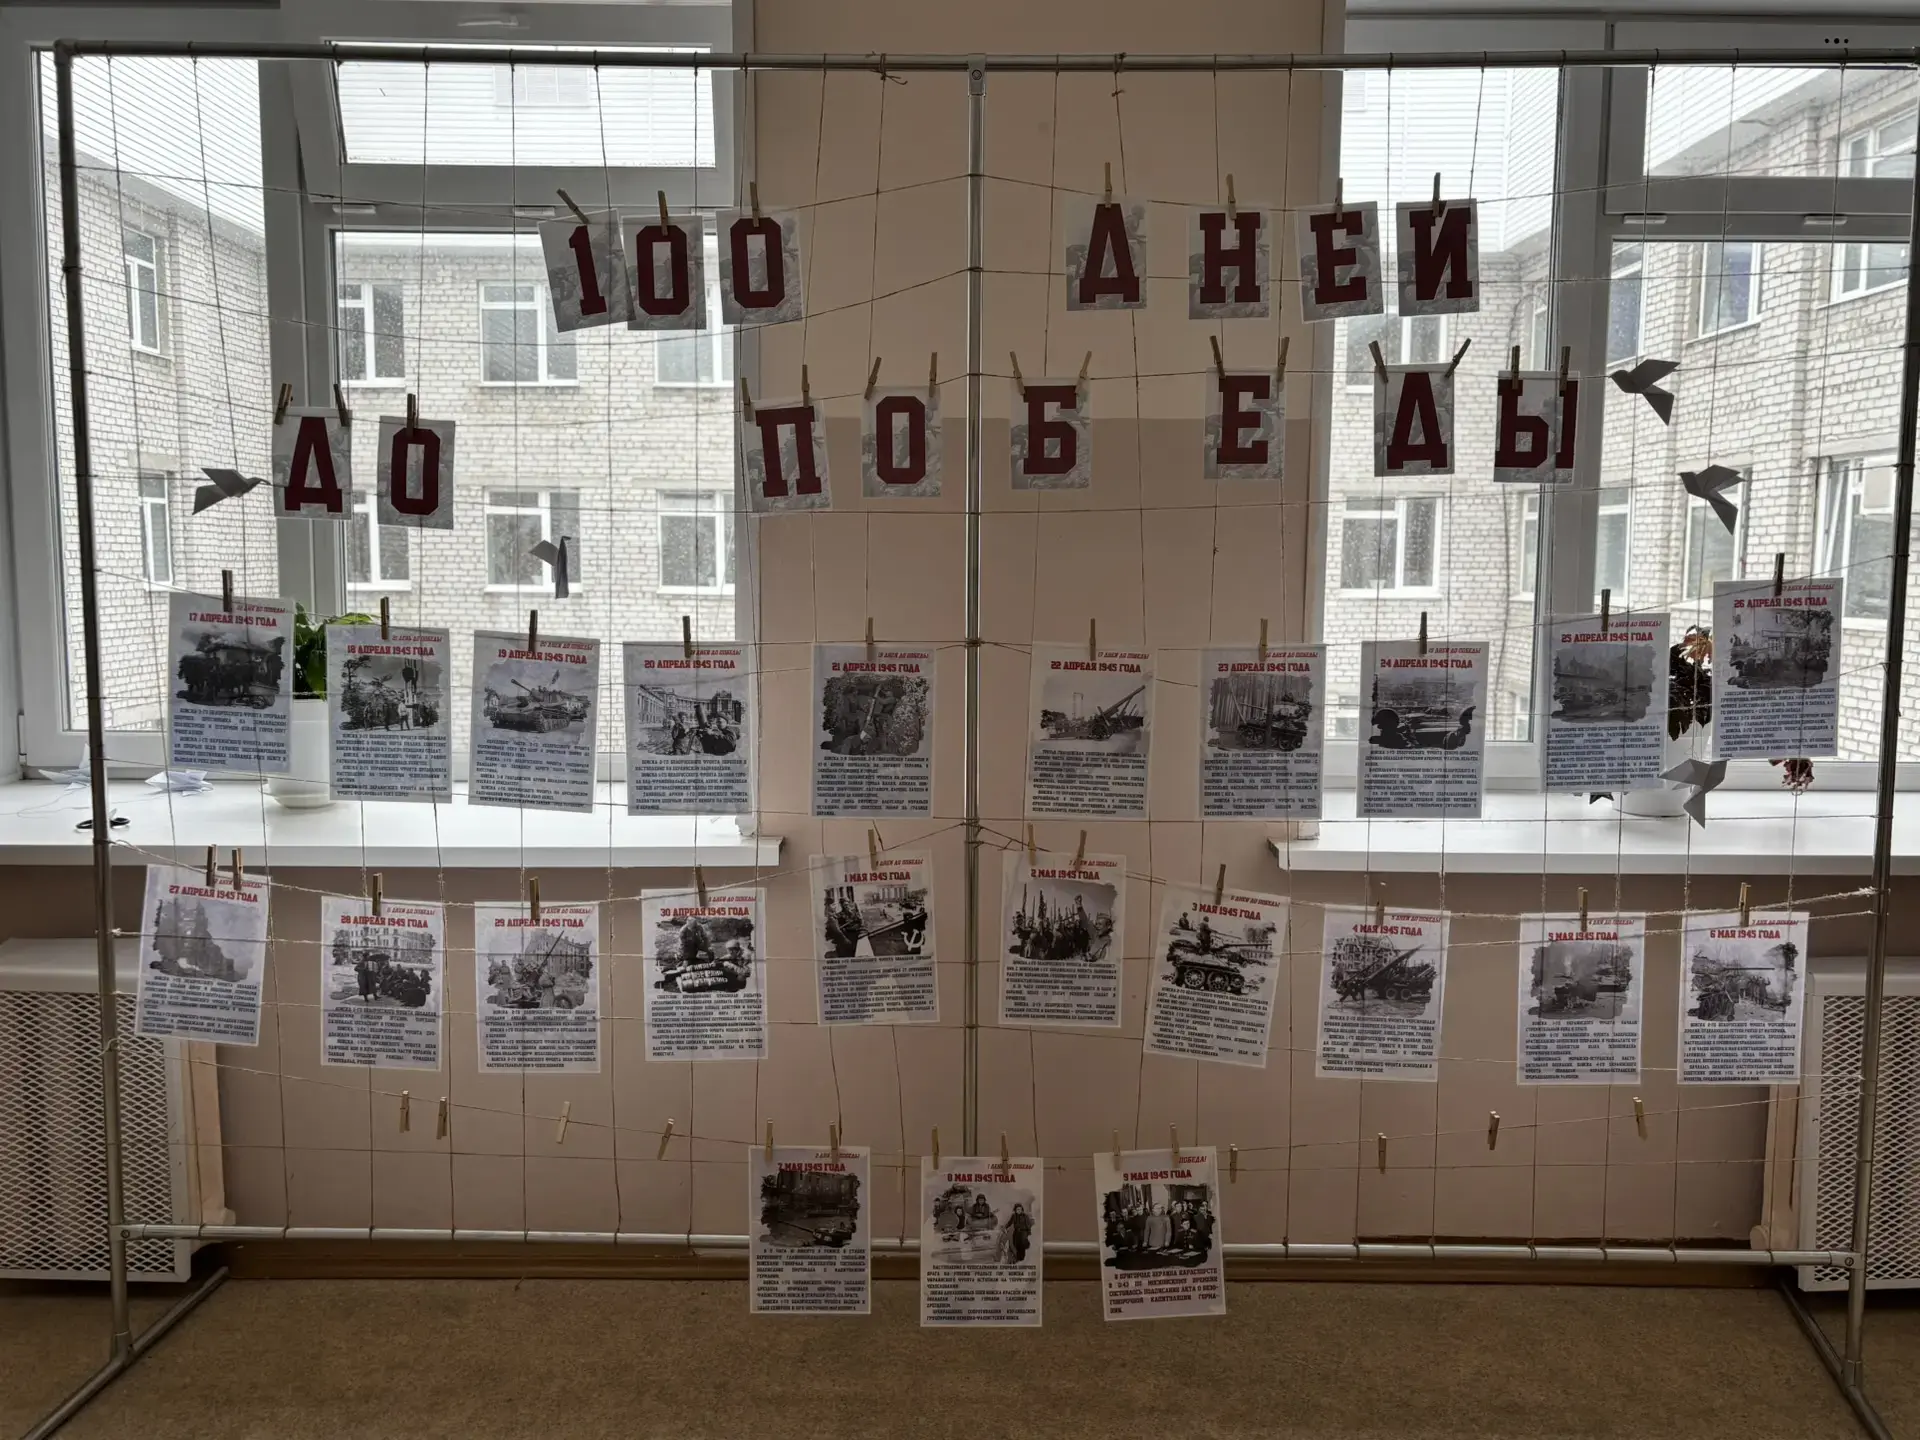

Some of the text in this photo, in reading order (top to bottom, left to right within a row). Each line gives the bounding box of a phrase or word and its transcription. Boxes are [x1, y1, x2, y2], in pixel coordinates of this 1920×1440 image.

[568, 217, 786, 316] 100
[284, 372, 1579, 516] ДО ПОБЕДЫ
[1734, 597, 1827, 608] 26 АПРЕЛЯ 1945 ГОДА
[189, 612, 277, 626] 17 АПРЕЛЯ 1945 ГОДА
[1562, 633, 1653, 642] 25 АПРЕЛЯ 1945 ГОДА
[348, 645, 355, 653] 18
[358, 646, 390, 654] АПРЕЛЯ
[413, 647, 434, 655] ГОДА
[498, 649, 587, 664] 19 АПРЕЛЯ 1945 ГОДА
[644, 660, 735, 668] 20 АПРЕЛЯ 1945 ГОДА
[832, 663, 840, 671] 21
[843, 663, 875, 672] АПРЕЛЯ
[899, 664, 920, 672] ГОДА
[1051, 661, 1141, 672] 22 АПРЕЛЯ 1945 ГОДА
[1288, 664, 1310, 672] ГОДА
[1380, 659, 1472, 668] 24 АПРЕЛЯ 1945 ГОДА
[844, 874, 847, 882] 1
[870, 873, 887, 881] 1945
[890, 872, 910, 880] ГОДА
[1031, 869, 1036, 877] 2
[1059, 870, 1076, 878] 1945
[1079, 871, 1100, 880] ГОДА
[169, 885, 257, 902] 27 АПРЕЛЯ 1945 ГОДА
[673, 908, 706, 916] АПРЕЛЯ
[708, 908, 725, 916] 1945
[728, 907, 749, 916] ГОДА
[1192, 903, 1261, 920] 3 МАЯ 1945 ГОДА
[353, 916, 385, 925] АПРЕЛЯ
[388, 918, 405, 926] 1945
[408, 919, 428, 928] ГОДА
[495, 919, 583, 927] 29 АПРЕЛЯ 1945 ГОДА
[1360, 925, 1378, 933] МАЯ
[1380, 926, 1398, 934] 1945
[1400, 927, 1422, 936] ГОДА
[1710, 930, 1780, 938] 6 МАЯ 1945 ГОДА
[1548, 932, 1617, 940] 5 МАЯ 1945 ГОДА
[785, 1163, 803, 1171] МАЯ
[804, 1163, 822, 1171] 1945
[824, 1163, 845, 1171] ГОДА
[955, 1174, 972, 1182] МАЯ
[975, 1174, 992, 1182] 1945
[995, 1174, 1015, 1182] ГОДА
[1171, 1170, 1192, 1178] ГОДА
